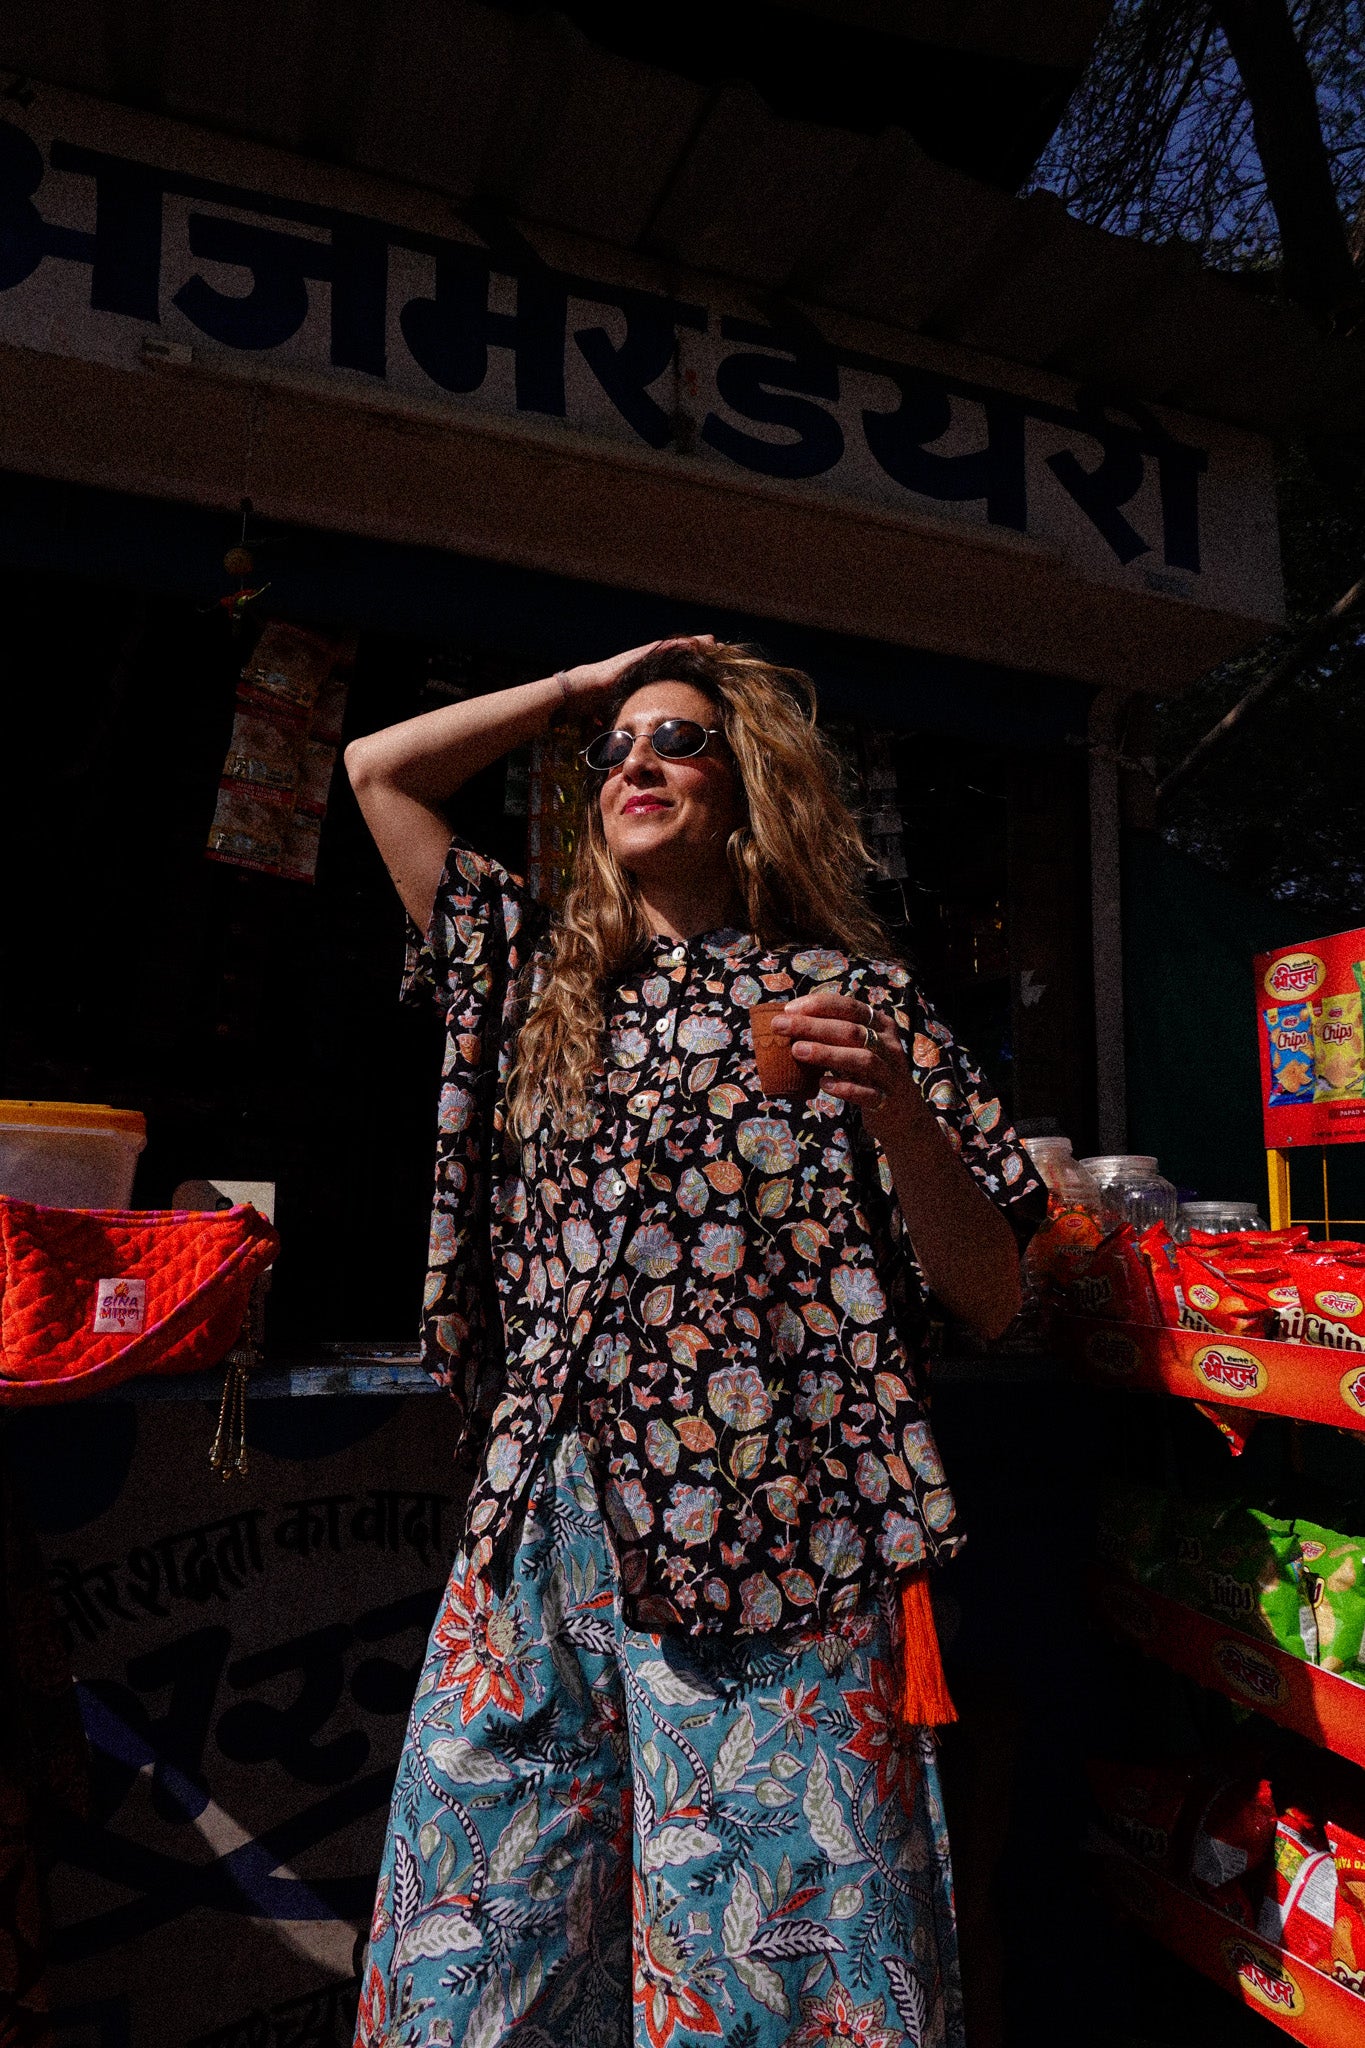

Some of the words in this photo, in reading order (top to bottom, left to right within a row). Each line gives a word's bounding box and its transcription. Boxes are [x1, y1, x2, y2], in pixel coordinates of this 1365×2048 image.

[701, 302, 1209, 575] डेयरी
[1277, 1032, 1307, 1050] Chips
[1322, 1024, 1353, 1044] Chips
[1199, 1351, 1259, 1390] श्रीराम
[275, 1494, 354, 1557] का
[352, 1490, 450, 1568] वादा
